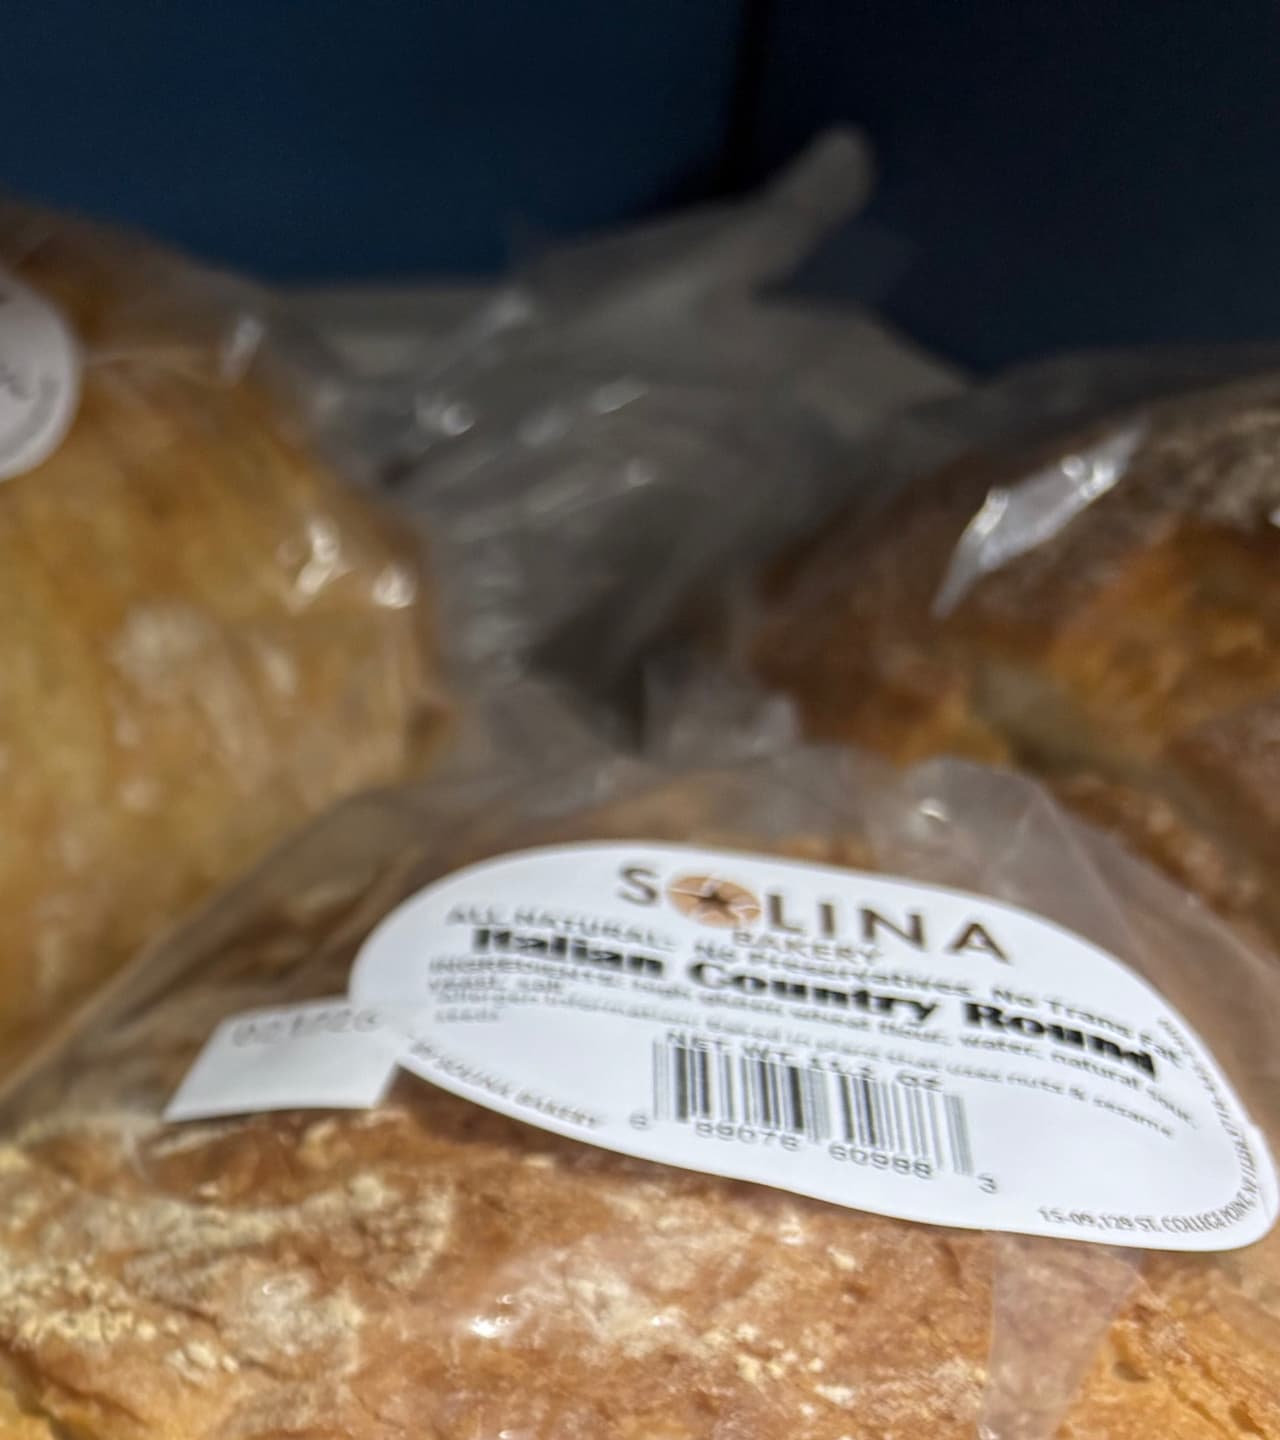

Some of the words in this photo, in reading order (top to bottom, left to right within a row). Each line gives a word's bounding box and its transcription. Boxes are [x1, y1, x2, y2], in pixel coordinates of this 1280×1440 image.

[471, 926, 665, 978] Italian
[689, 961, 942, 1024] Country
[961, 1000, 1157, 1080] Round
